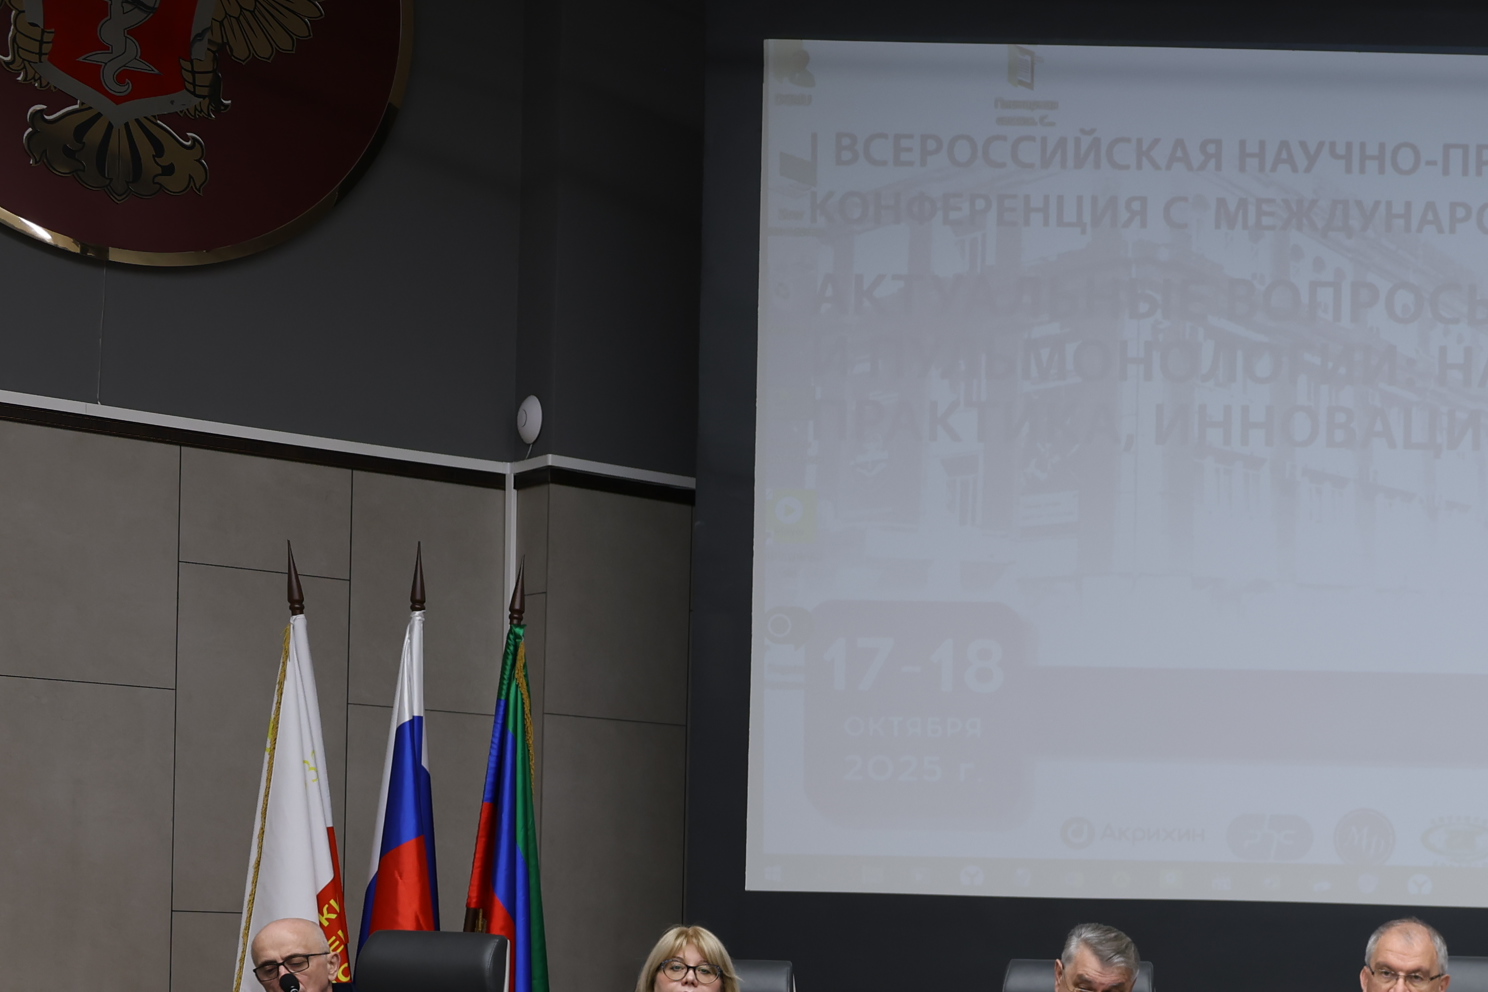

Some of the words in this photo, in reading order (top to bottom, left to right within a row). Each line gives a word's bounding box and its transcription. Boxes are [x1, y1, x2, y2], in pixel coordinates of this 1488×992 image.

[834, 128, 1223, 173] ВСЕРОССИЙСКАЯ
[810, 190, 1148, 235] КОНФЕРЕНЦИЯ
[1163, 195, 1189, 231] С
[823, 637, 1004, 693] 17-18
[844, 716, 982, 739] ОКТЯБРЯ
[843, 755, 943, 782] 2025
[1101, 822, 1206, 846] Акрихин
